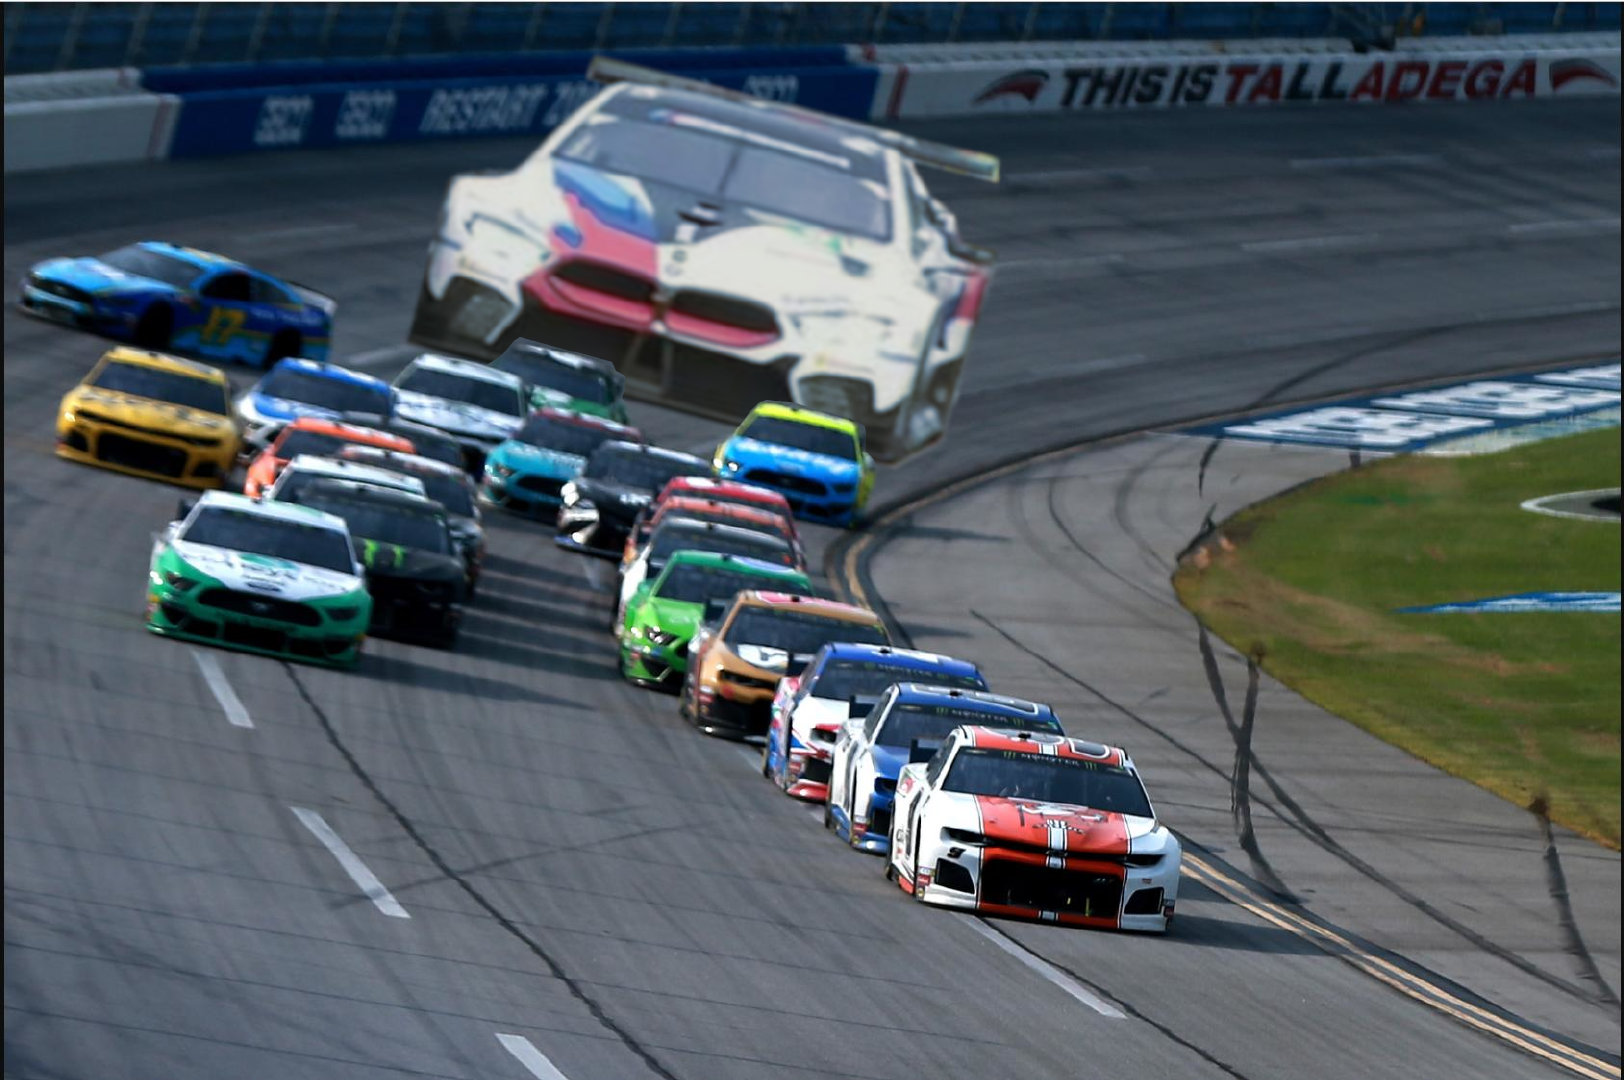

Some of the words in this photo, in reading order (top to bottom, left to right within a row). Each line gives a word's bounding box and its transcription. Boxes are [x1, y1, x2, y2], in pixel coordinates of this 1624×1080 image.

[1060, 65, 1172, 107] THIS
[1169, 64, 1218, 102] IS
[1225, 58, 1537, 104] TALLADEGA
[1021, 753, 1081, 767] MONSTER
